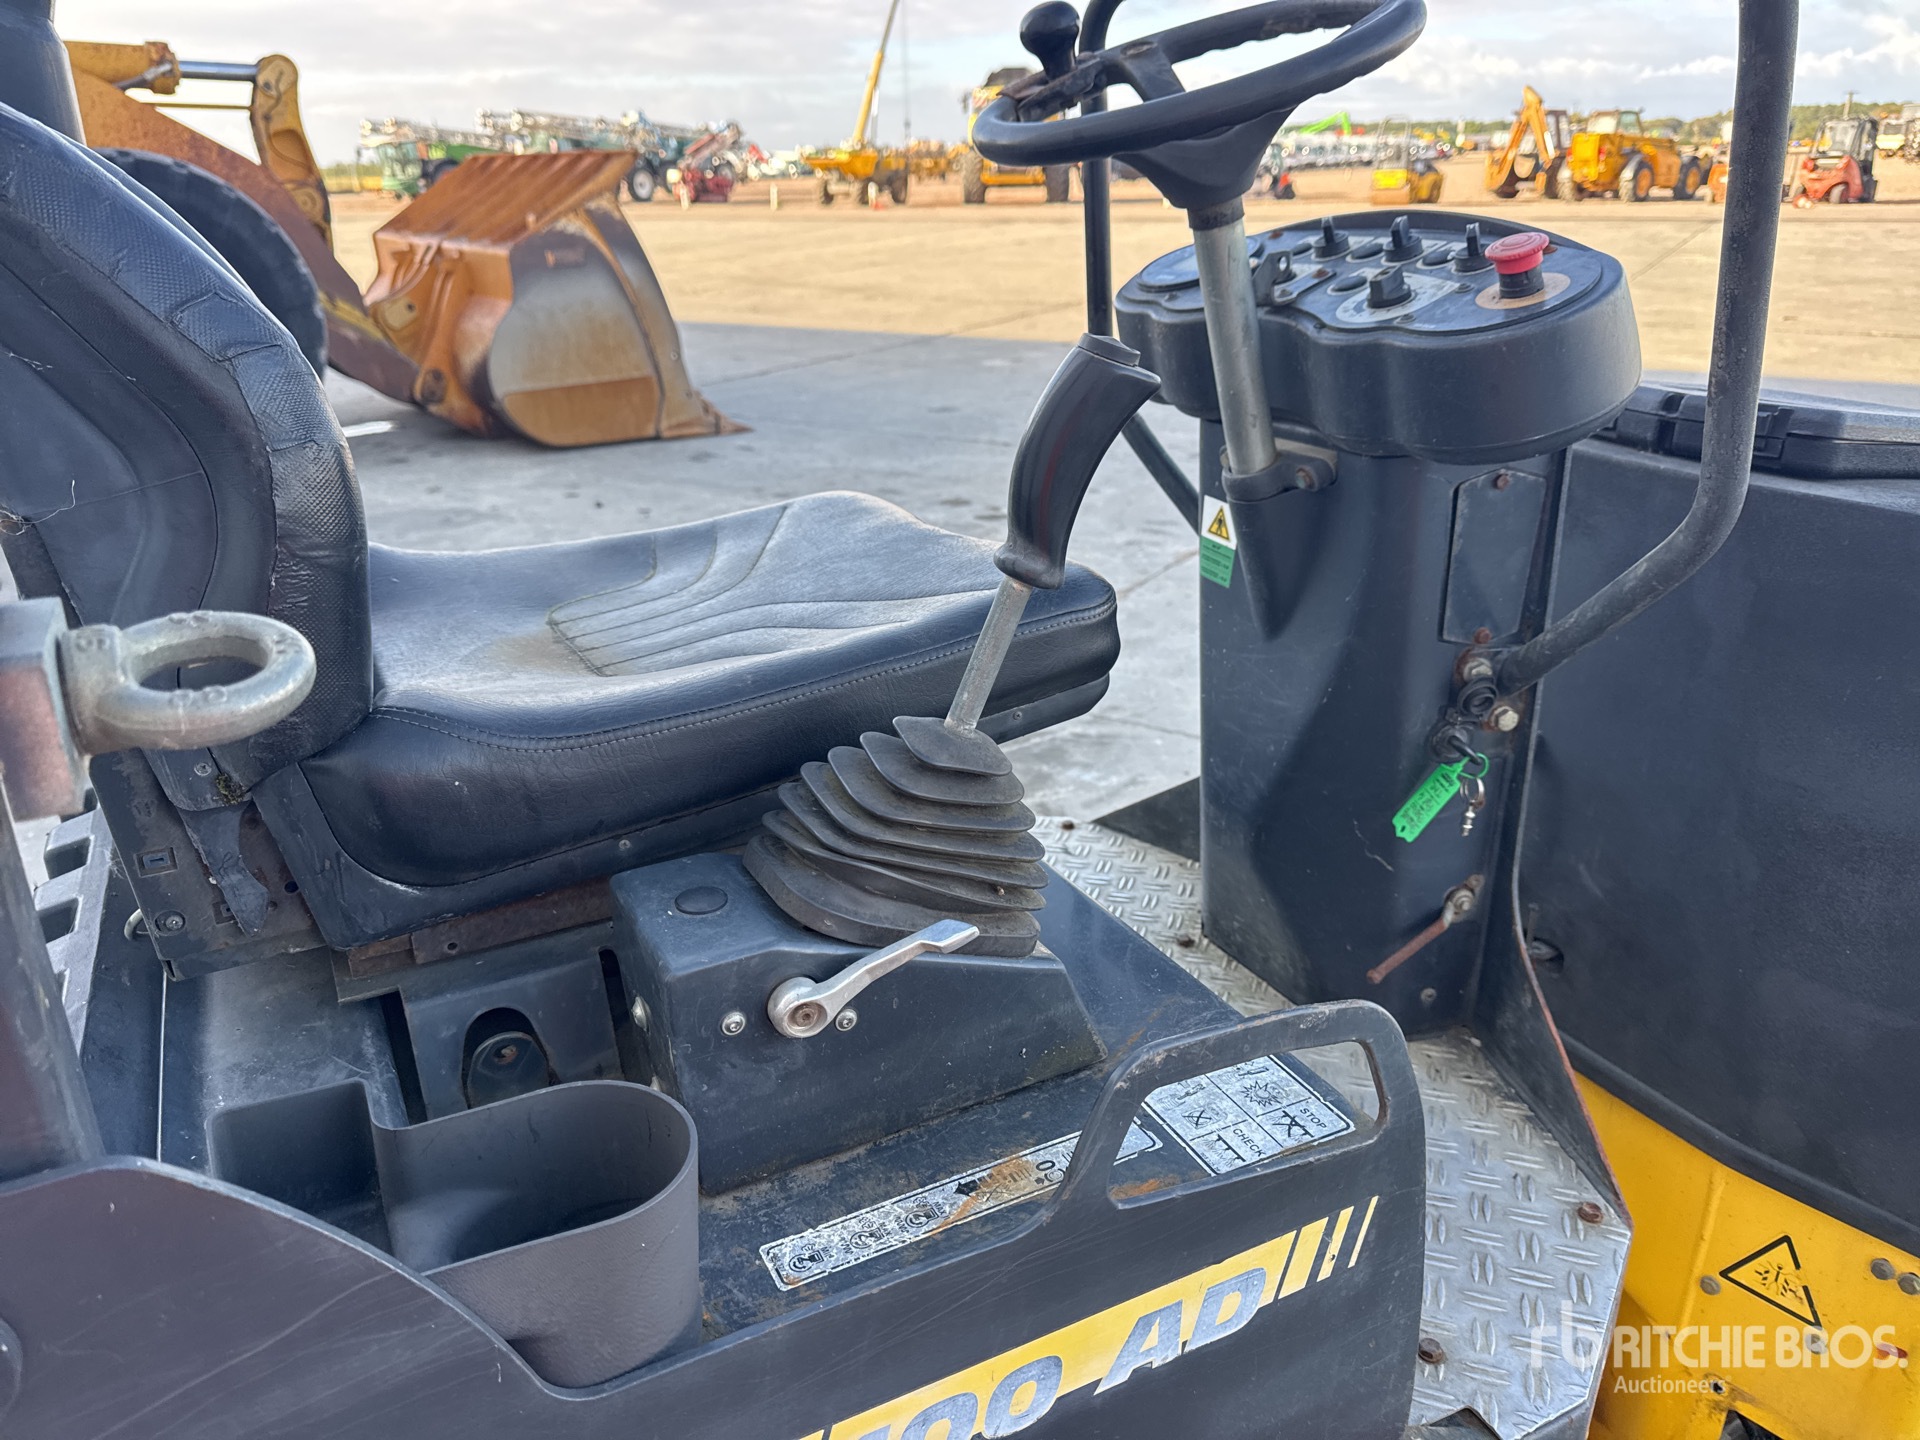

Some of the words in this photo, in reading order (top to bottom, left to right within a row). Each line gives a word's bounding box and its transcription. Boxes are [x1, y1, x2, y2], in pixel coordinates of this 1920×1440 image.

[1300, 1107, 1327, 1129] STOP
[1233, 1128, 1266, 1157] CHECK
[858, 1355, 1063, 1439] 00
[1093, 1267, 1266, 1396] AD
